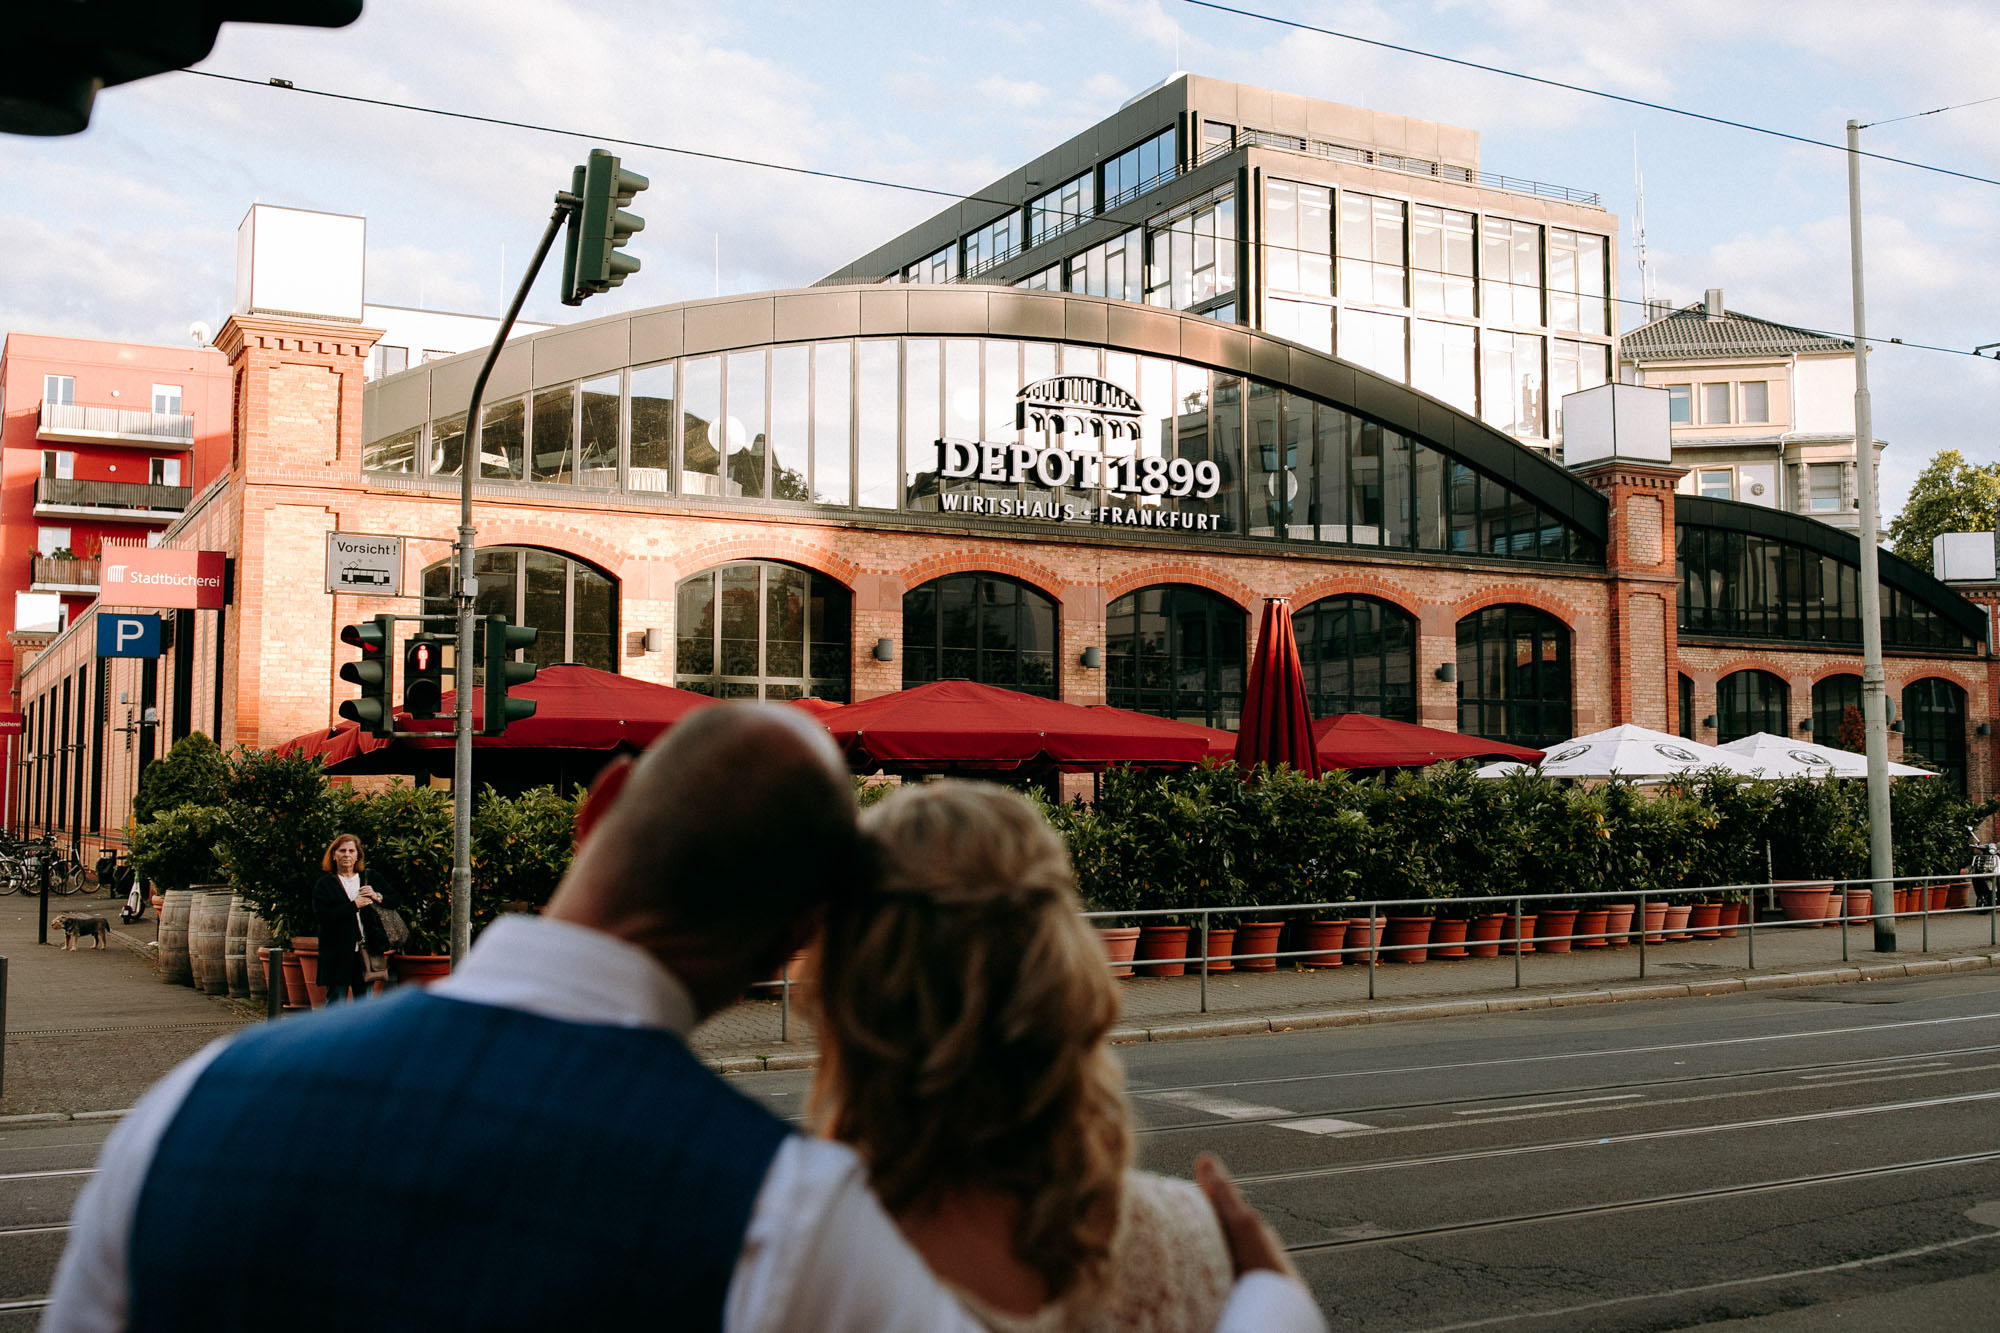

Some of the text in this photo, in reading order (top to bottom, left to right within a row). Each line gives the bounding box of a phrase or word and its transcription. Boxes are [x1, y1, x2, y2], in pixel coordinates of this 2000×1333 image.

[940, 436, 1222, 499] DEPOT 1899
[941, 493, 1221, 531] WIRTSHAUS FRANKFURT
[130, 571, 220, 588] Stadtbücherei
[116, 619, 145, 652] P
